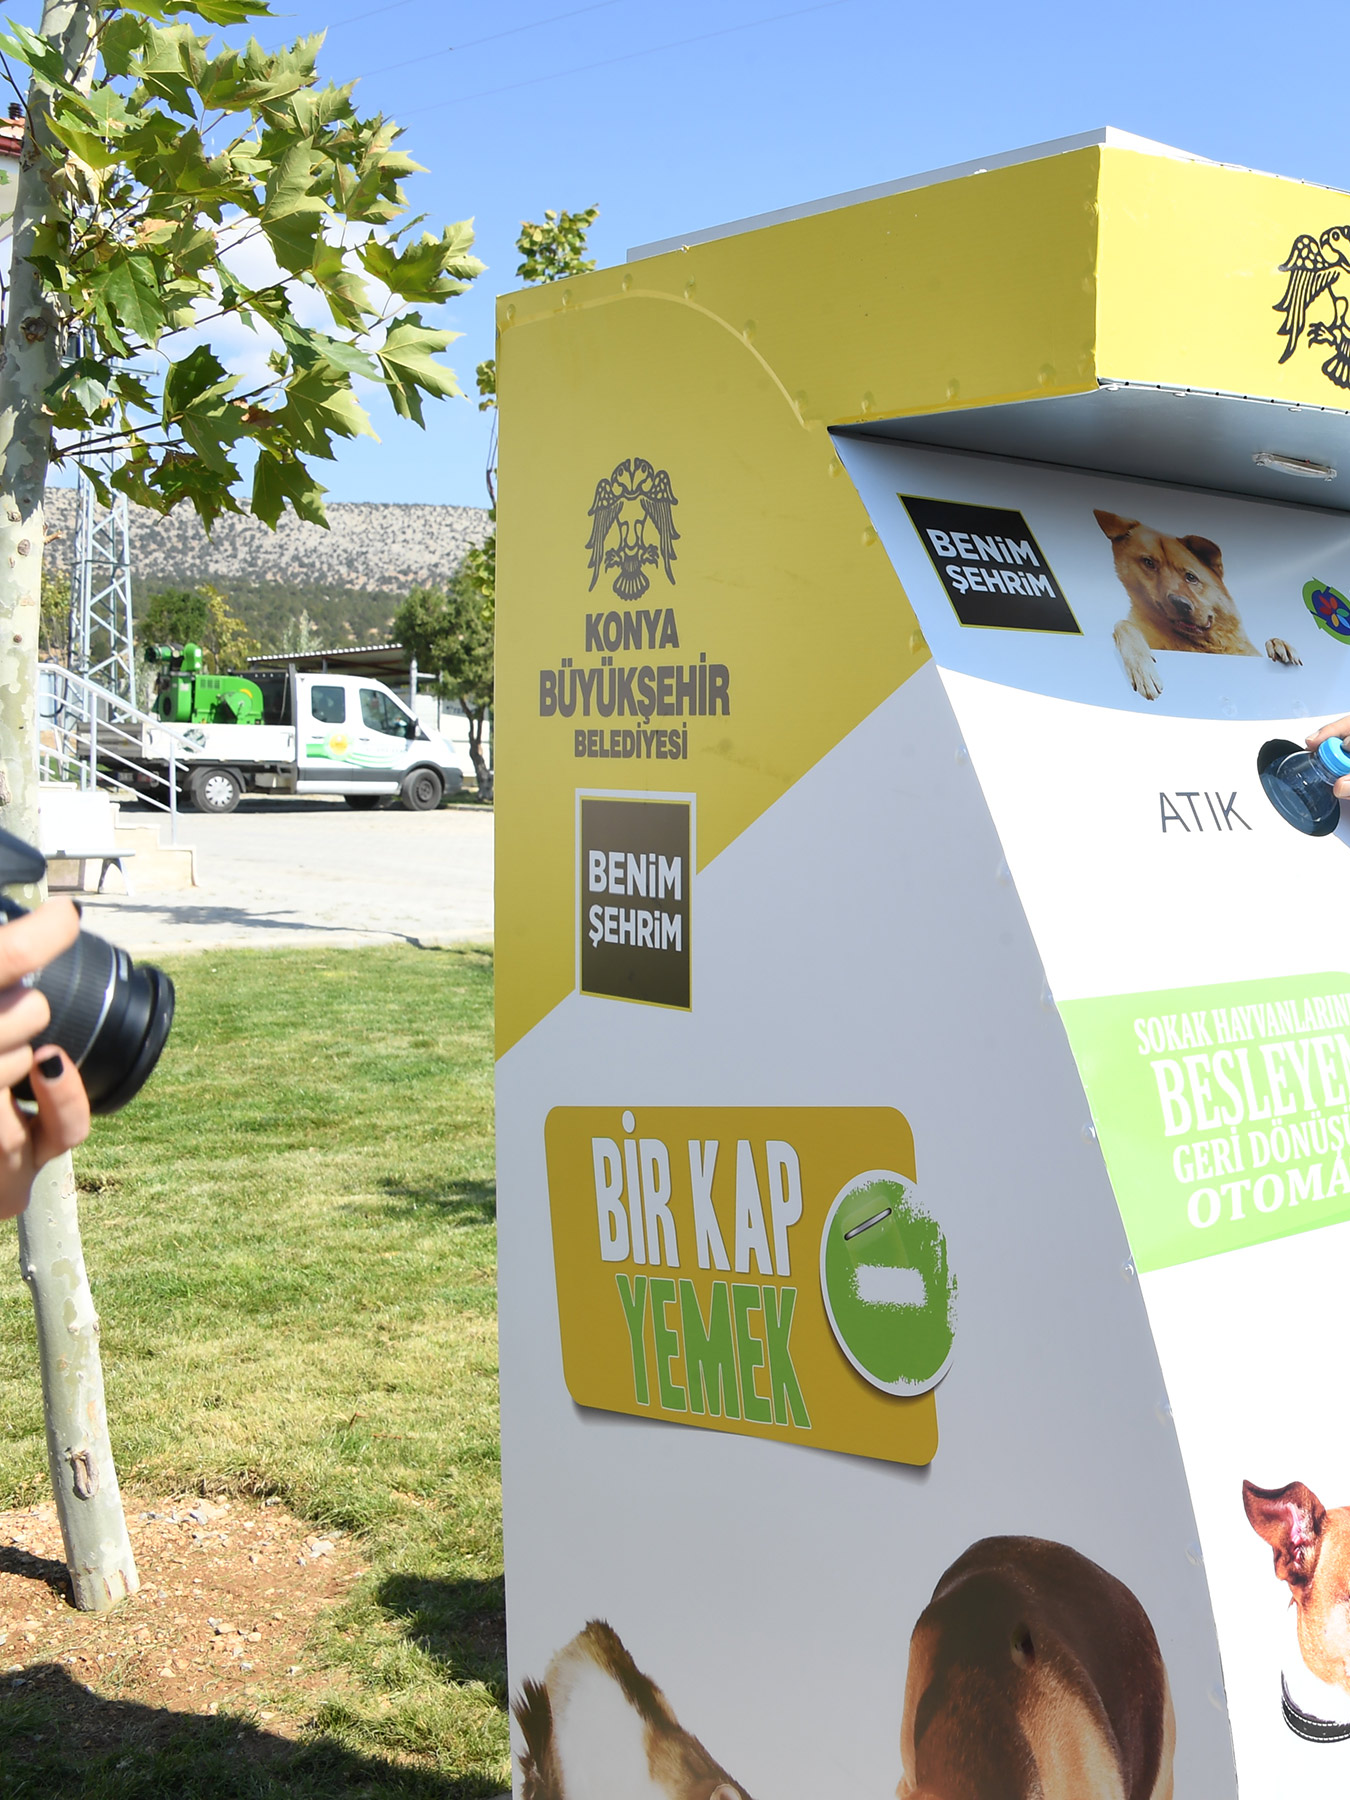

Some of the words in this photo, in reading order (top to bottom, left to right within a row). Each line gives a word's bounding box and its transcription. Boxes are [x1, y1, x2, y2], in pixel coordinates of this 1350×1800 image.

[585, 607, 680, 652] KONYA
[539, 652, 730, 723] BÜYÜKŞEHİR
[574, 722, 688, 760] BELEDİYESİ
[1159, 790, 1252, 833] ATIK
[1133, 1010, 1214, 1056] SOKAK
[1172, 1126, 1245, 1184] GERİ
[591, 1109, 681, 1268] BİR
[687, 1138, 804, 1277] KAP
[614, 1273, 813, 1430] YEMEK
